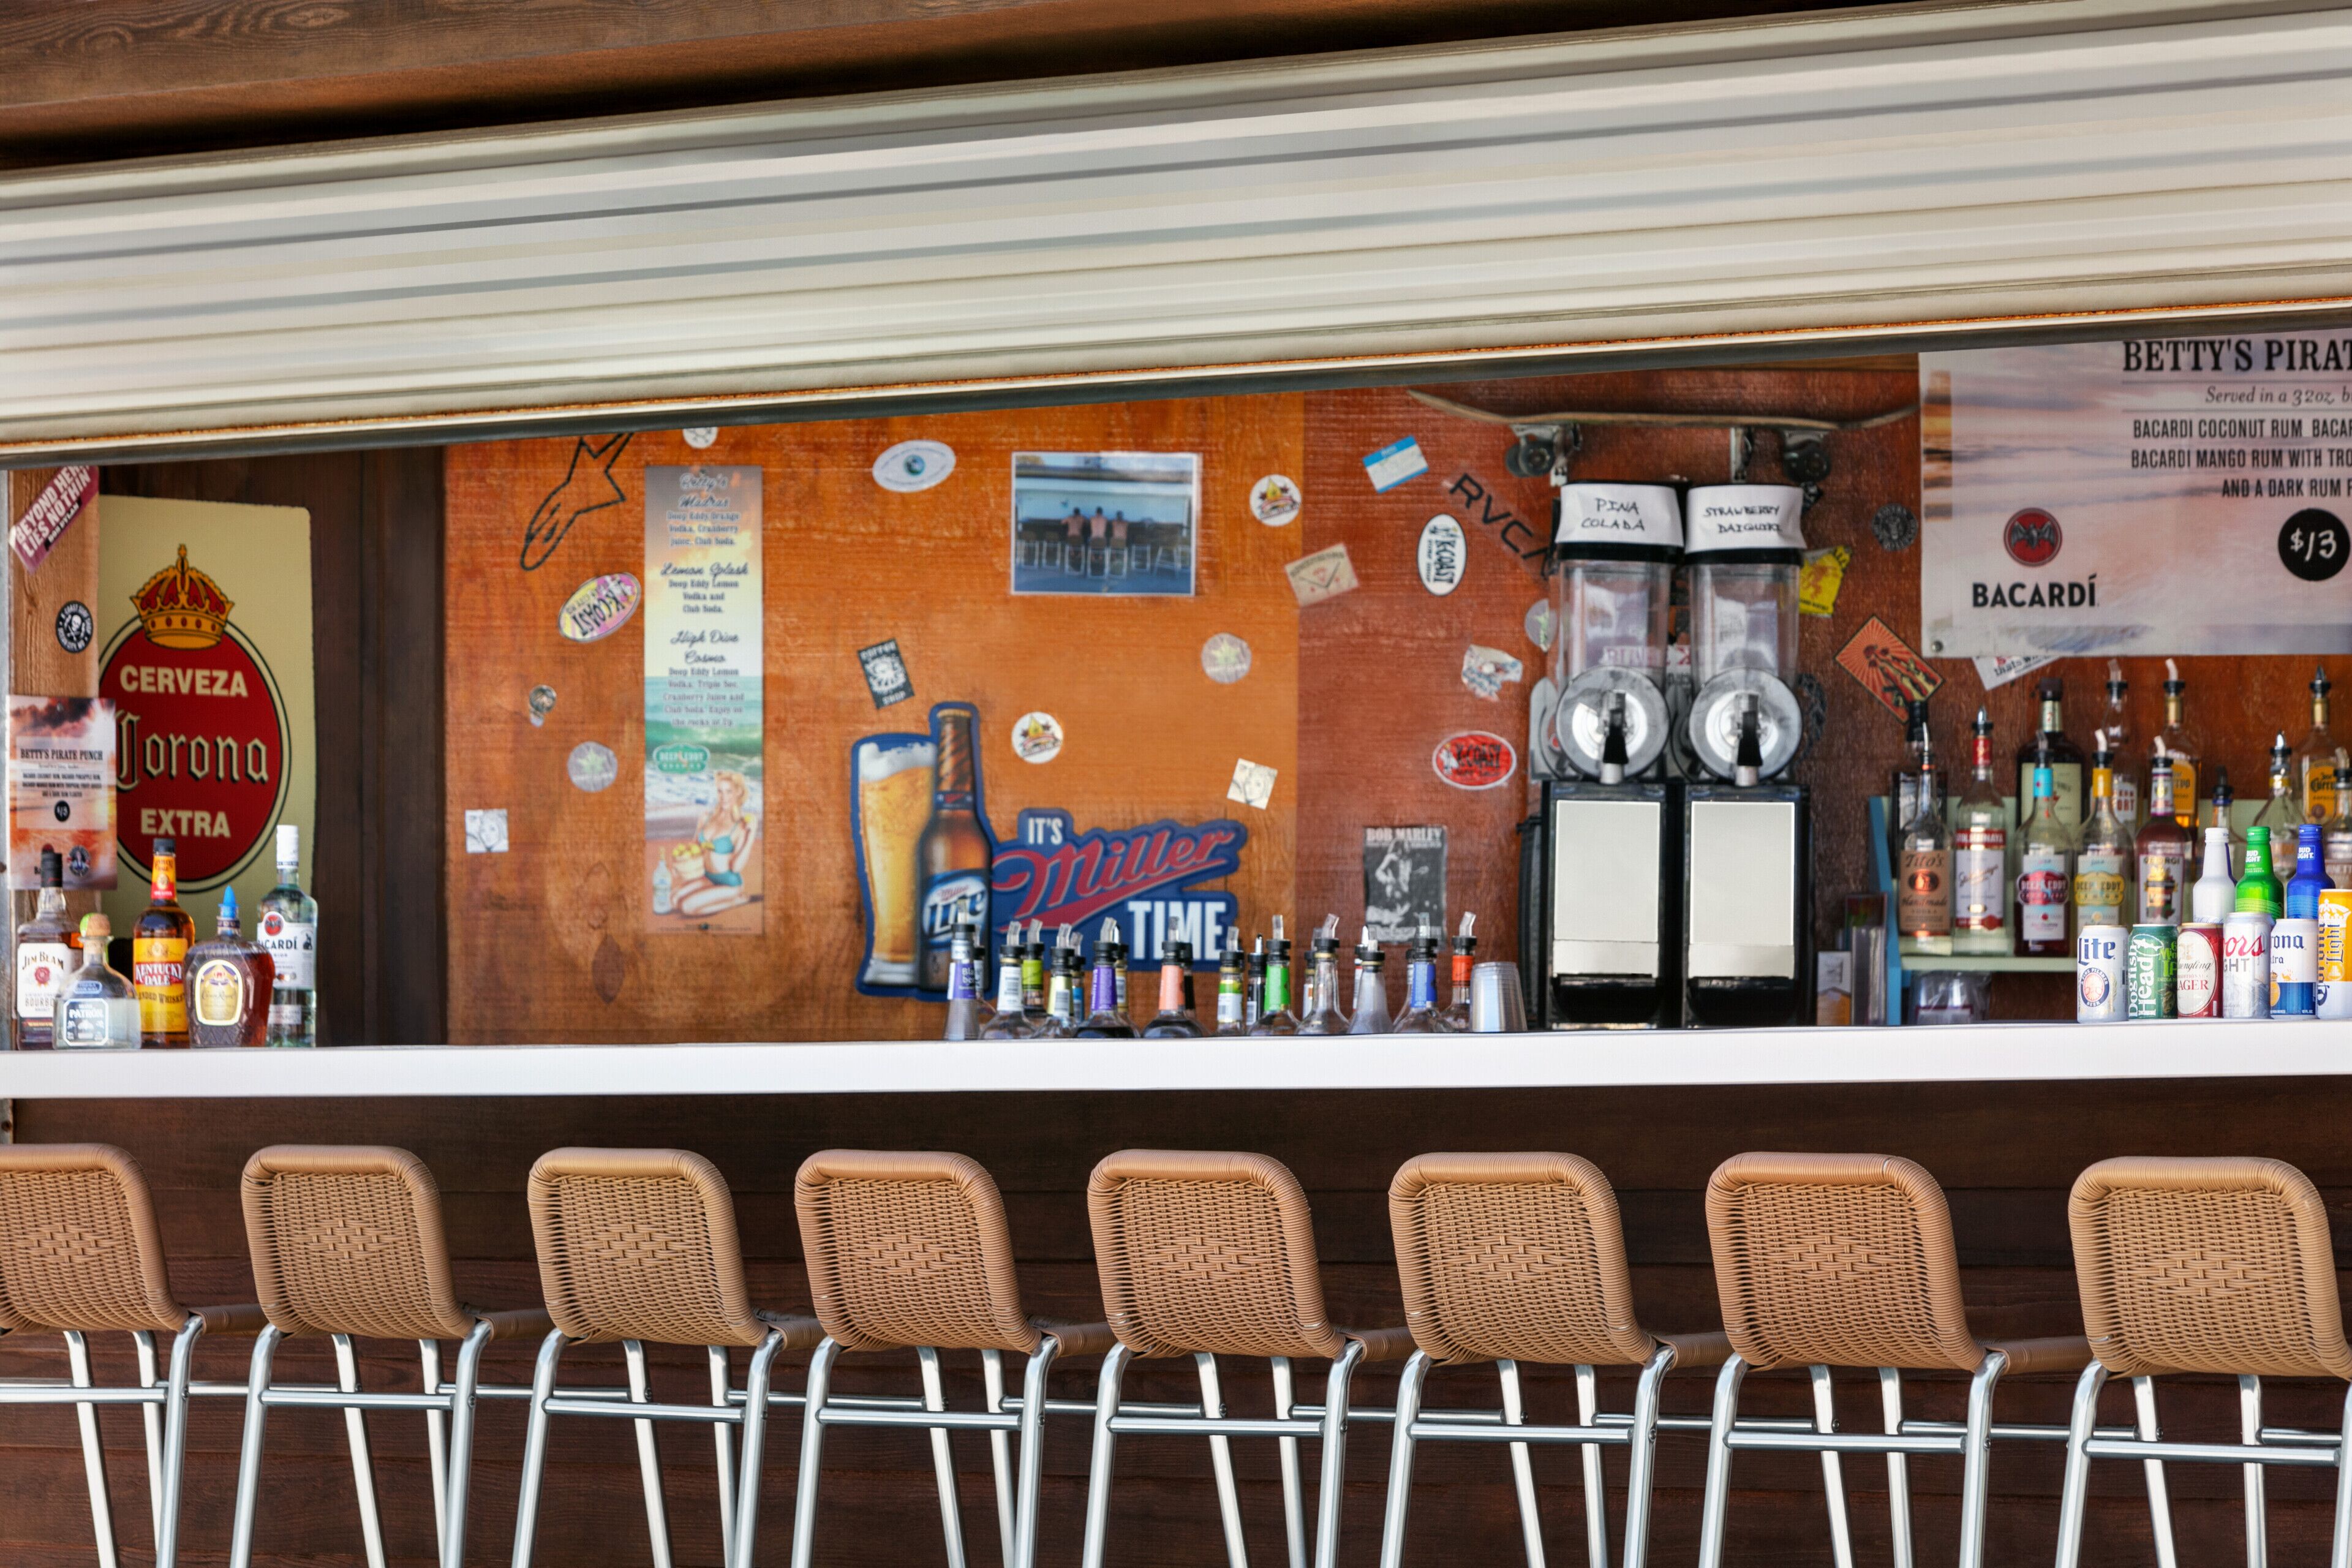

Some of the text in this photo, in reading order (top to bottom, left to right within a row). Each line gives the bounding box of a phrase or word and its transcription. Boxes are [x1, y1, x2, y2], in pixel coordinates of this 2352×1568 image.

[2122, 339, 2253, 372] BETTY'S
[2205, 385, 2256, 404] Served
[2260, 386, 2274, 404] in
[2277, 393, 2288, 404] a
[2133, 418, 2193, 439] BACARDI
[2198, 418, 2266, 439] COCONUT
[2131, 448, 2191, 469] BACARDI
[2196, 448, 2246, 469] MANGO
[2251, 448, 2283, 469] RUM
[2287, 448, 2322, 468] WITH
[2222, 478, 2250, 498] AND
[2254, 479, 2264, 497] A
[2268, 478, 2304, 497] DARK
[2309, 478, 2342, 497] RUM
[16, 486, 58, 545] BEYOND
[1580, 518, 1645, 532] COLADA
[1703, 504, 1780, 518] STRAWBERRY
[21, 519, 50, 558] LIES
[2290, 527, 2338, 562] $13
[1972, 573, 2097, 608] BACARDÍ
[119, 665, 249, 698] CERVEZA
[20, 748, 103, 761] BETTY'S PIRATE PUNCH
[140, 807, 232, 839] EXTRA
[1028, 816, 1063, 845] IT'S
[992, 830, 1235, 919] Miller
[1905, 853, 1944, 868] Tito's
[1128, 900, 1227, 961] TIME
[2078, 938, 2116, 966] Lite
[135, 962, 183, 981] KENTUCKY
[144, 974, 171, 986] DALE
[2177, 979, 2209, 990] AGER
[2137, 956, 2157, 1016] Head
